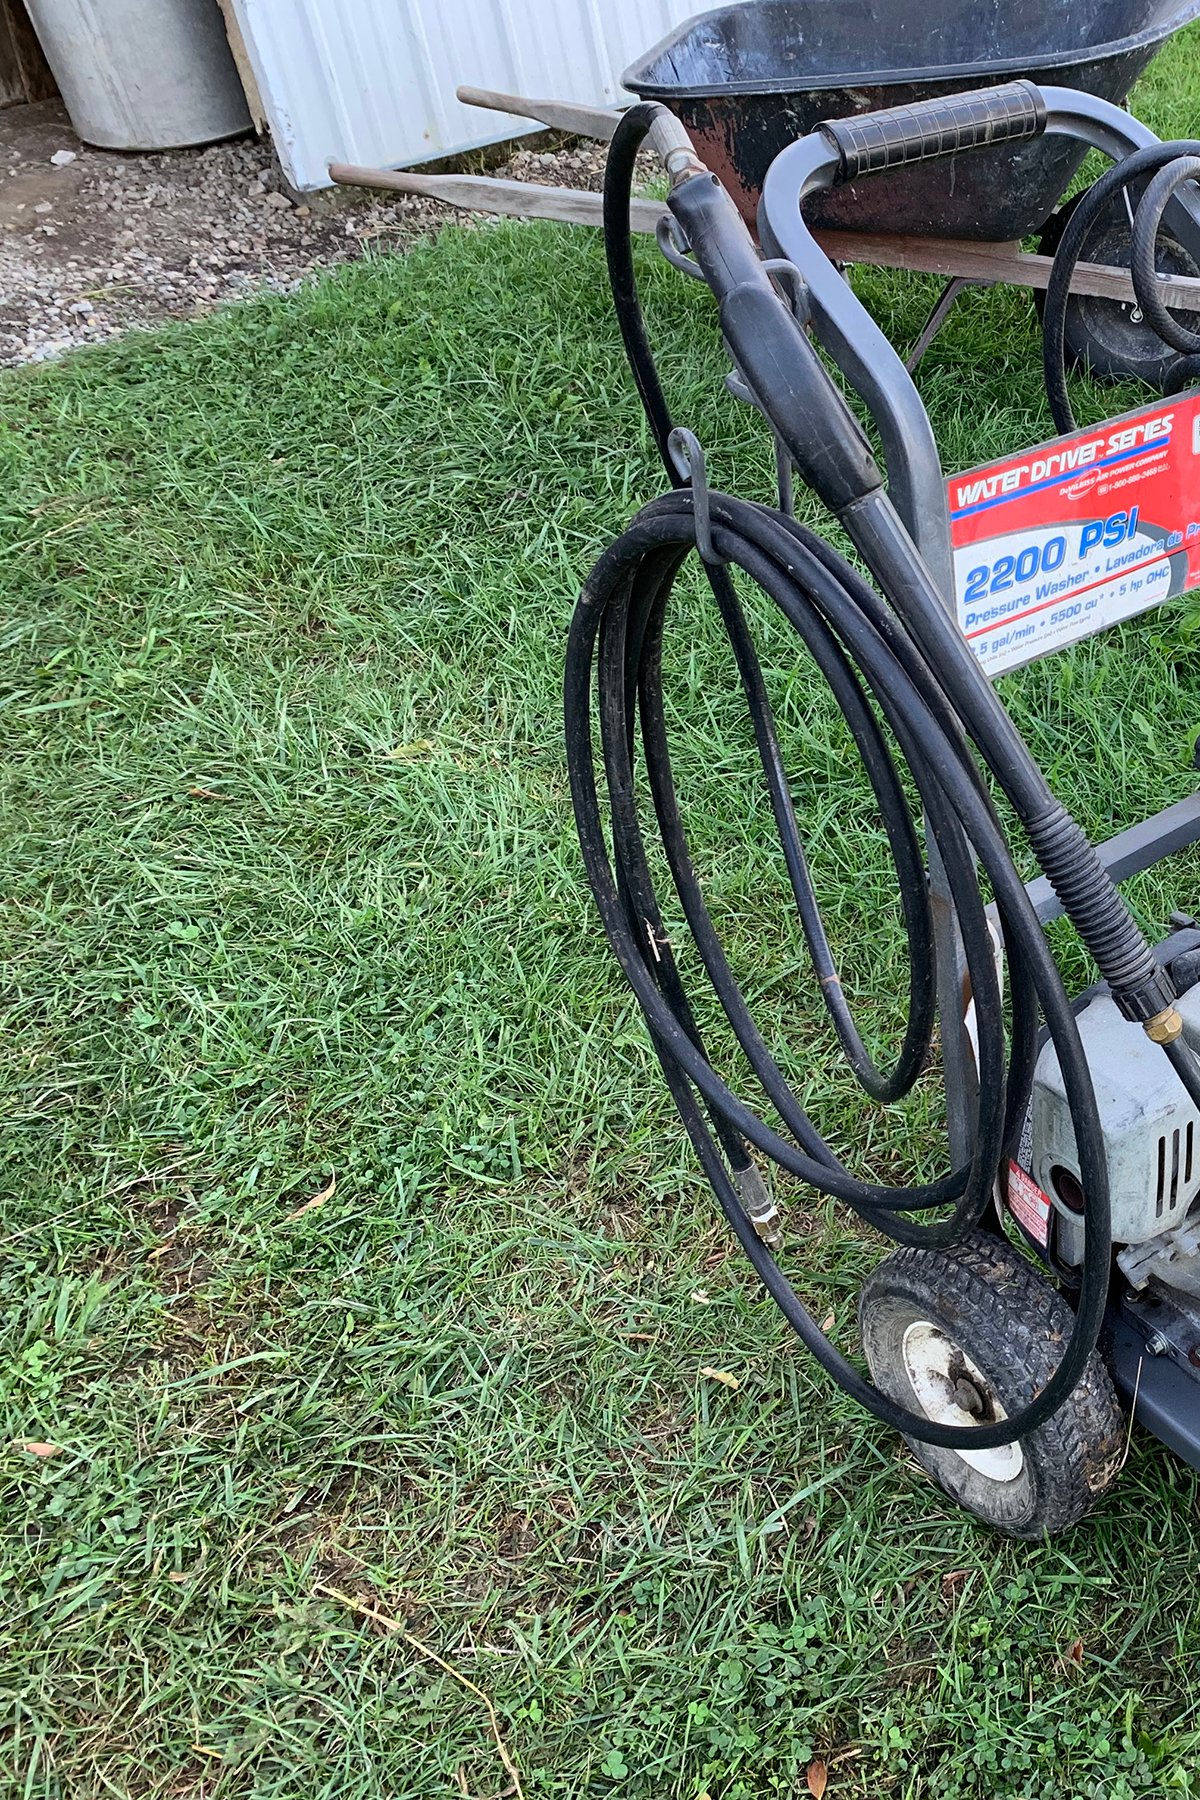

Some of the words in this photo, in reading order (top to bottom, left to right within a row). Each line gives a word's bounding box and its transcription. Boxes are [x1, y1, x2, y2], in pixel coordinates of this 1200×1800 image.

[957, 465, 1029, 507] WATER
[1030, 440, 1104, 482] DRIVER
[1106, 413, 1174, 455] SERIES
[1110, 463, 1135, 478] POWER
[1135, 450, 1169, 467] COMPANY
[964, 536, 1067, 605] 2200
[1079, 505, 1139, 559] PSI
[965, 594, 1030, 629] Pressure
[1035, 570, 1089, 601] Washer
[1105, 539, 1165, 572] Lavadora
[1166, 530, 1183, 548] de
[991, 624, 1035, 653] gal/min
[1050, 602, 1082, 625] 5500
[1118, 584, 1127, 596] 5
[1130, 580, 1143, 592] hp
[1146, 565, 1170, 585] OHC
